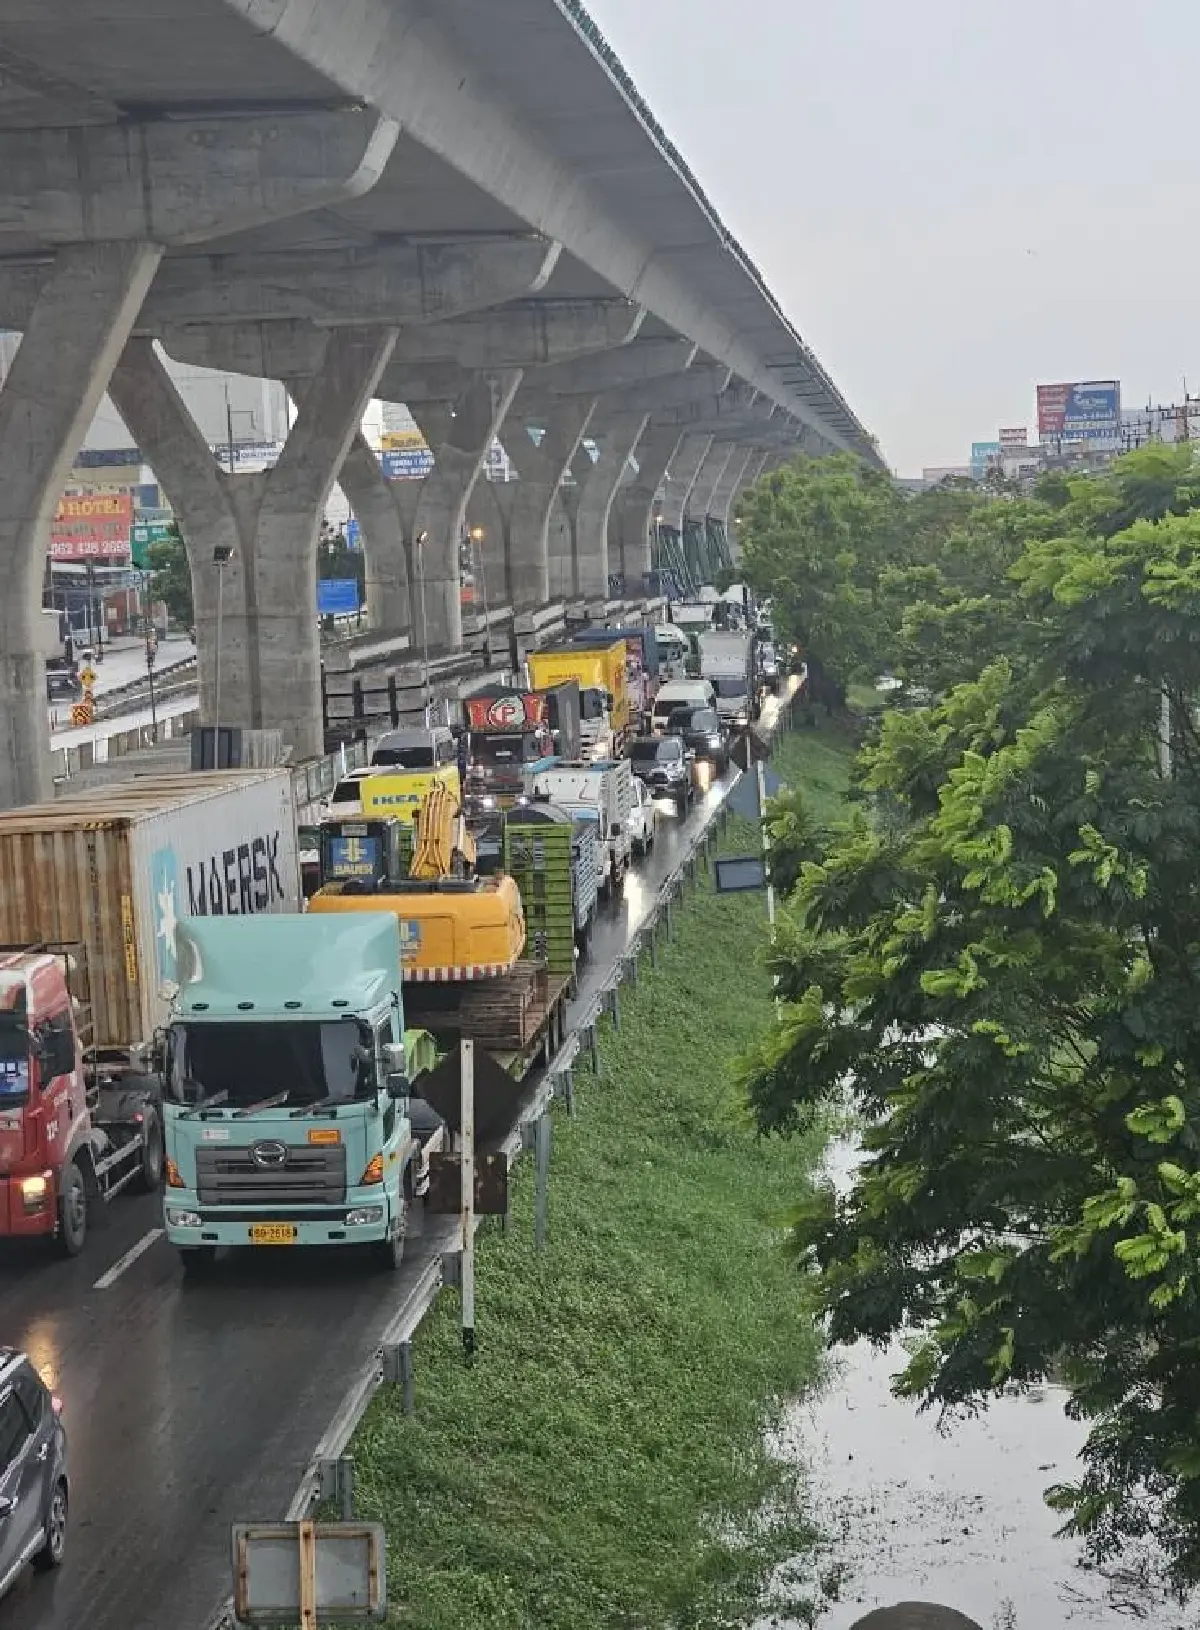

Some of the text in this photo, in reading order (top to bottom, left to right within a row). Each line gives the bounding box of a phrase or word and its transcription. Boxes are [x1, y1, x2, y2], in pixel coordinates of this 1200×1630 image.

[68, 499, 125, 516] HOTEL
[372, 794, 420, 805] IKEA
[186, 830, 285, 917] MAERSK
